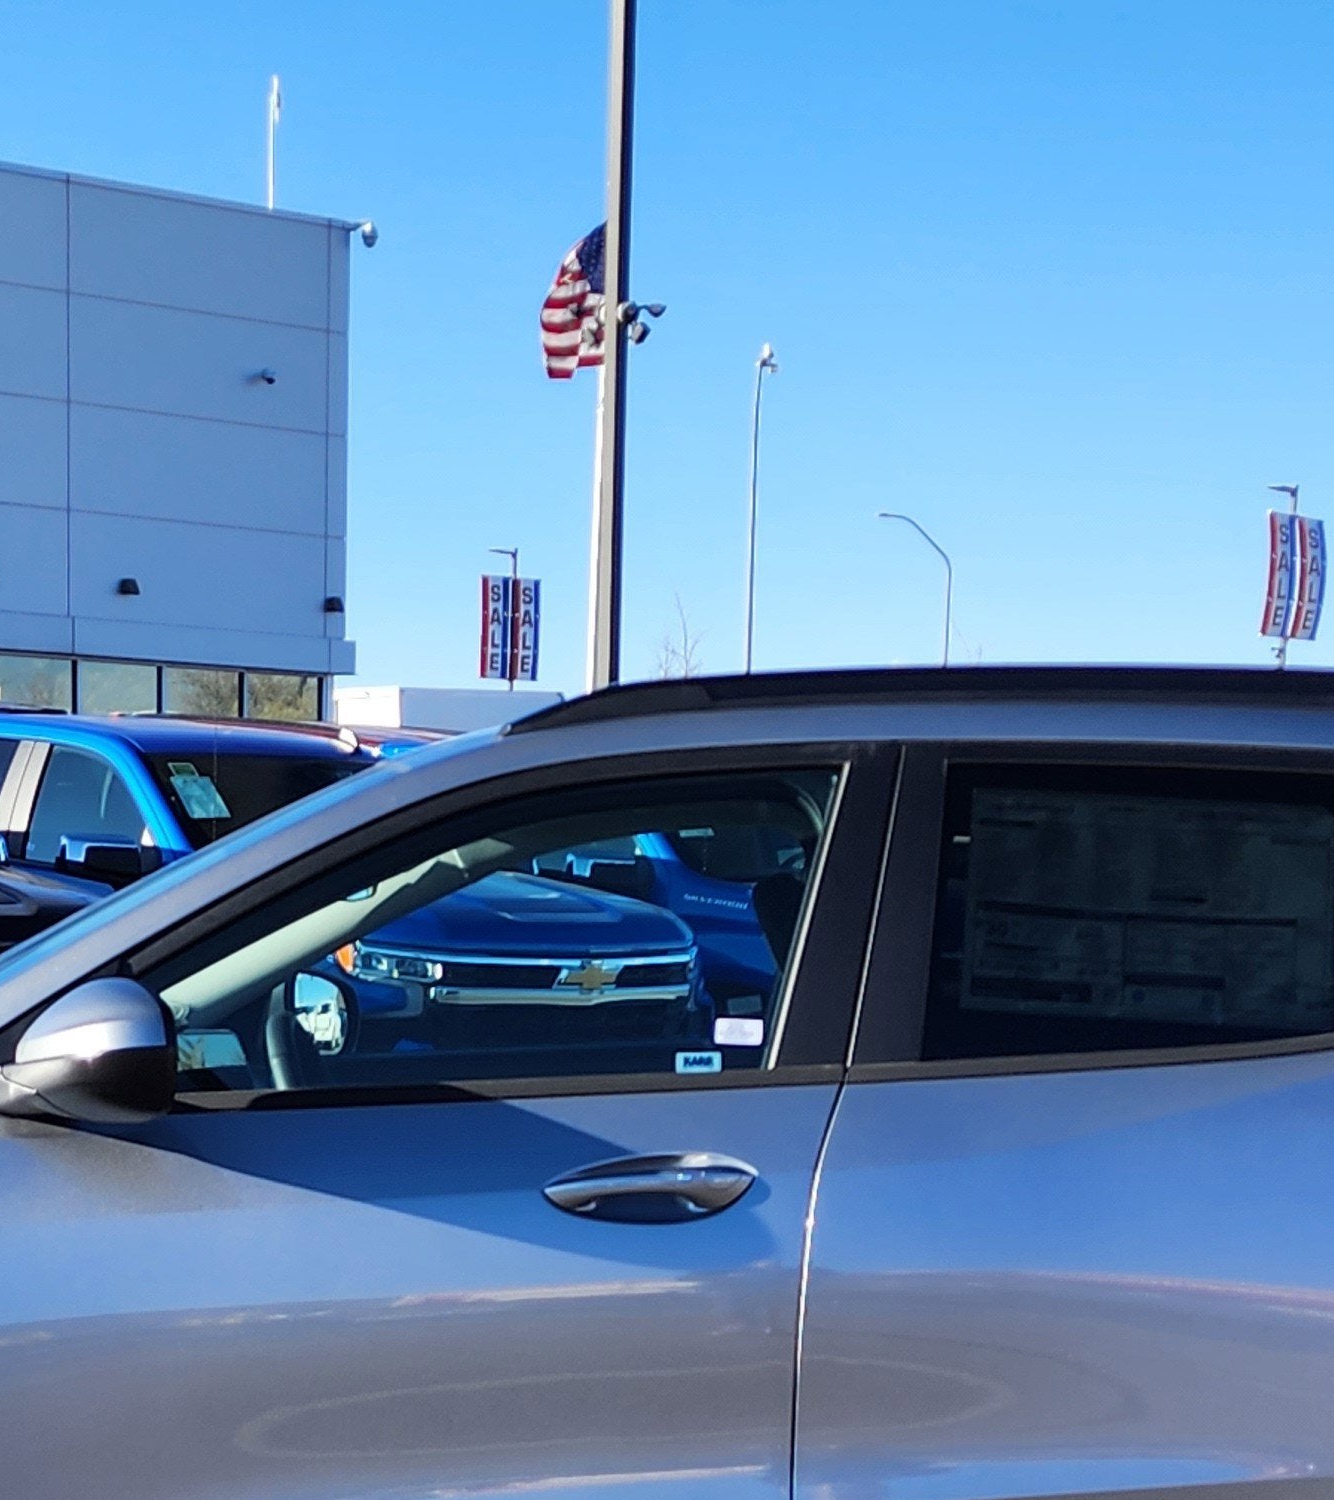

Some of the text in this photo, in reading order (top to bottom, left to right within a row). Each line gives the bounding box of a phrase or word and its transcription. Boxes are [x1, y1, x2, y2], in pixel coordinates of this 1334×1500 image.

[1271, 524, 1290, 627] SALE
[1302, 528, 1321, 630] SALE
[489, 584, 501, 672] SALE
[520, 587, 534, 673] SALE
